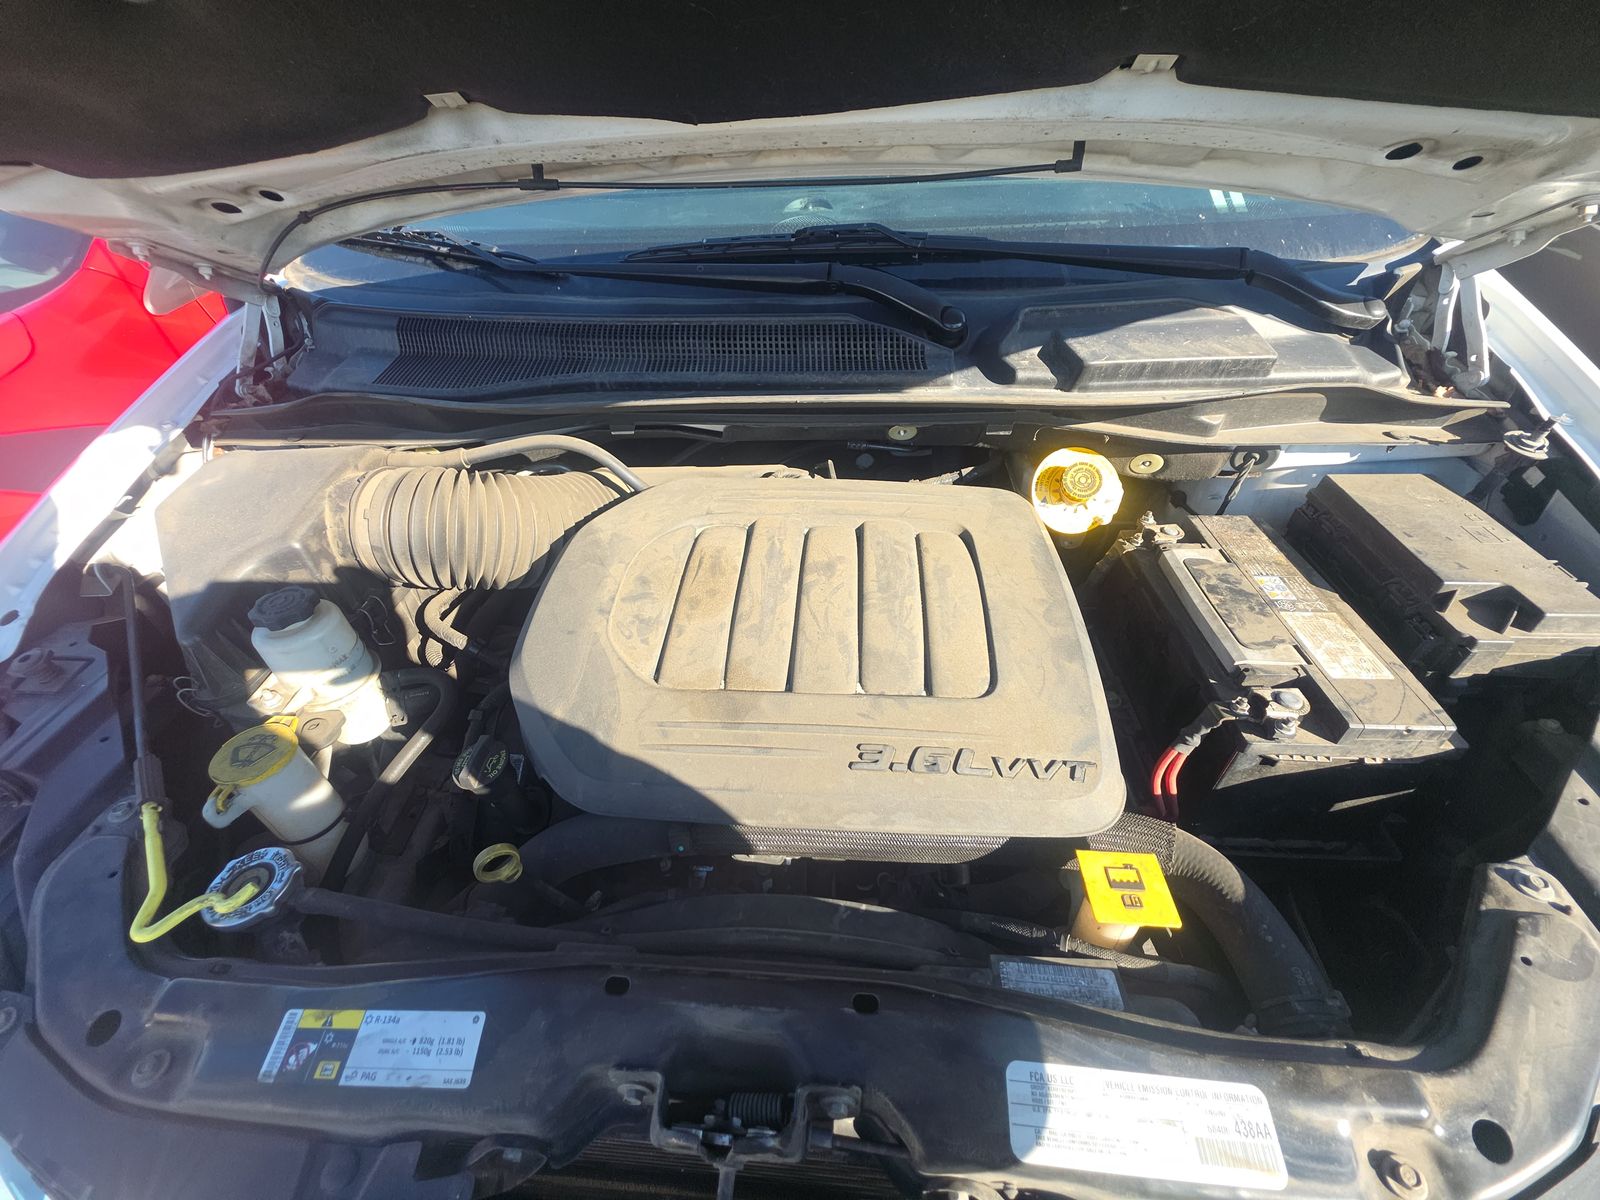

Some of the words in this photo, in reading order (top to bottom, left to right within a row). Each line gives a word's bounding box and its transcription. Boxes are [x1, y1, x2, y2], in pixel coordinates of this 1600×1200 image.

[991, 755, 1098, 783] VVT
[374, 1016, 401, 1025] R-134a
[418, 1037, 435, 1047] 820g
[438, 1037, 455, 1047] (1.81
[412, 1047, 432, 1057] 1150g
[436, 1047, 453, 1057] (2.53
[360, 1071, 377, 1082] PAG
[1029, 1071, 1045, 1083] FCA
[1047, 1072, 1059, 1084] US
[1060, 1074, 1075, 1086] LLC
[1105, 1080, 1136, 1093] VEHICLE
[1137, 1083, 1174, 1096] EMISSION
[1211, 1090, 1264, 1105] INFORMATION
[1234, 1119, 1273, 1140] 438AA
